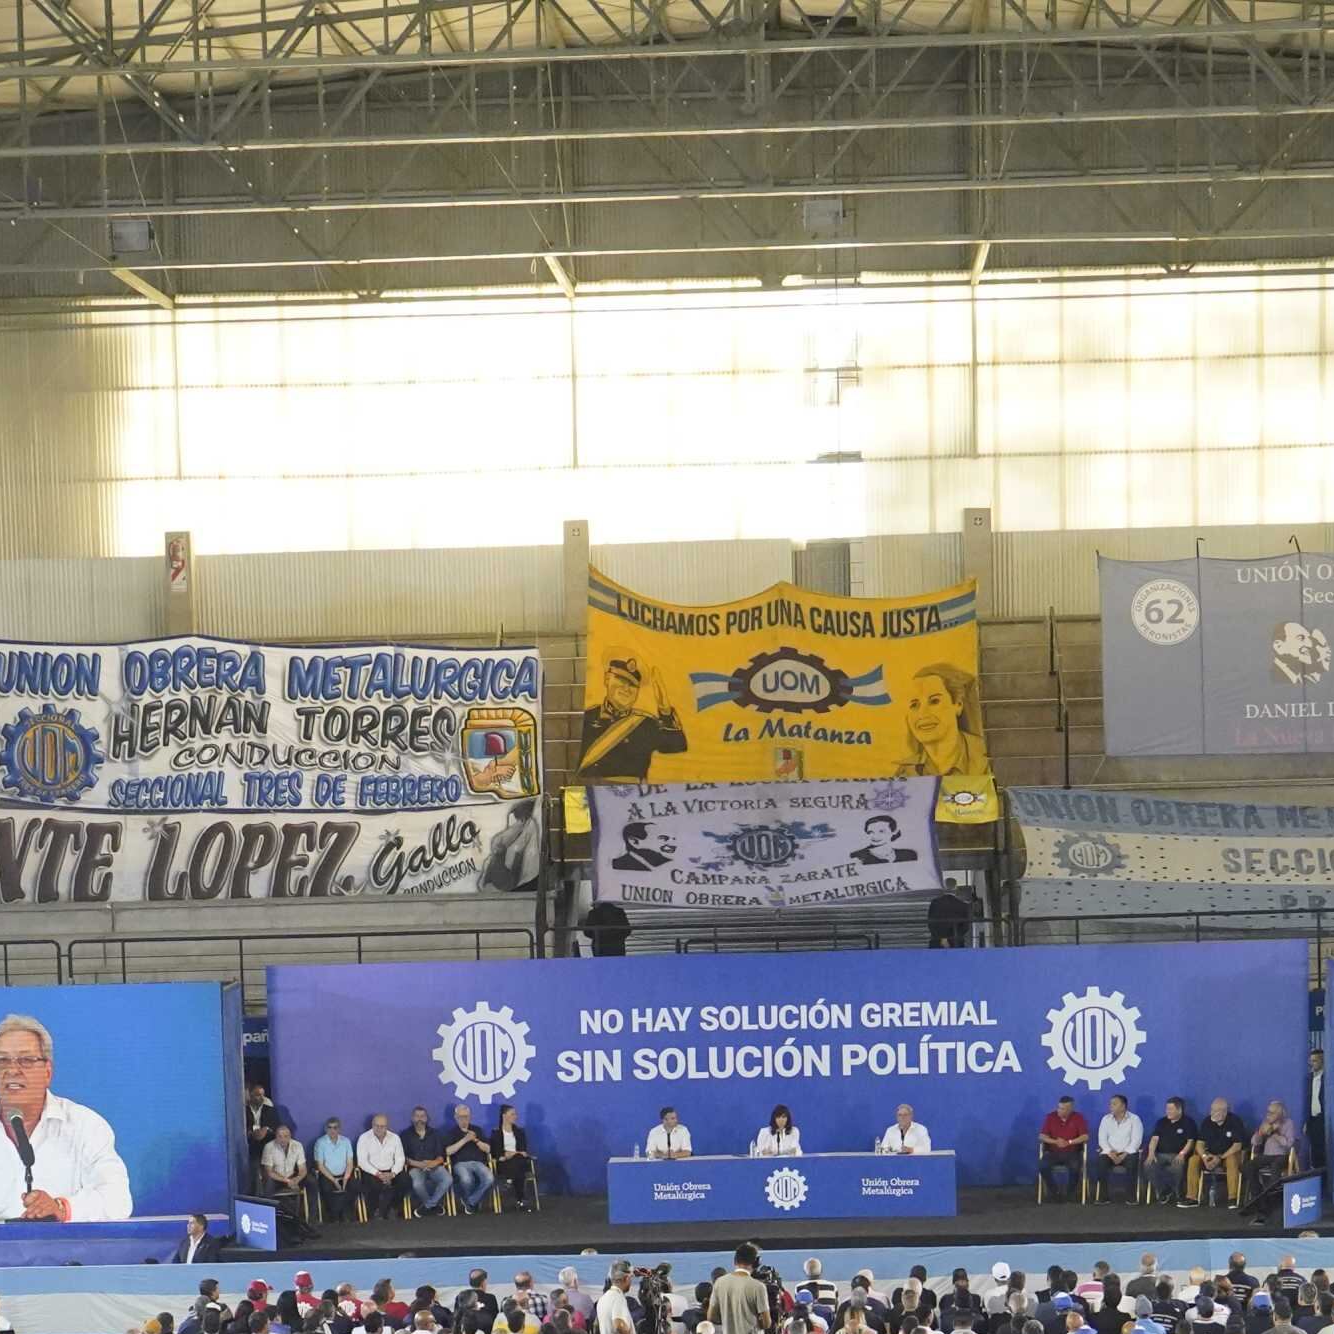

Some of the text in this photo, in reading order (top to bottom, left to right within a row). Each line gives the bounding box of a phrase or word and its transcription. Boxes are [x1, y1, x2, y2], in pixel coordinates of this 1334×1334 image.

[1236, 561, 1309, 584] UNIÓN
[615, 596, 720, 637] LUCHAMOS
[725, 605, 763, 635] POR
[767, 598, 806, 630] UNA
[809, 607, 875, 639] CAUSA
[1144, 599, 1186, 625] 62
[124, 645, 266, 697] OBRERA
[287, 653, 538, 701] METALURGICA
[762, 669, 821, 696] UOM
[1244, 702, 1323, 719] DANIEL
[111, 696, 457, 760] HERNAN TORRES
[722, 717, 873, 745] La Matanza
[171, 741, 401, 770] CONDUCCION
[108, 771, 228, 809] SECCIONAL
[244, 771, 304, 807] TRES
[315, 773, 348, 808] DE
[358, 773, 462, 808] FEBRERO
[626, 794, 870, 822] A LA VICTORIA SEGURA
[1130, 799, 1266, 831] OBRERA
[147, 819, 363, 900] LOPEZ
[371, 814, 481, 894] Gallo
[779, 863, 860, 885] ZARATE
[620, 876, 911, 908] UNION OBRERA METALURGICA
[579, 999, 998, 1035] NO HAY SOLUCIÓN GREMIAL
[455, 1022, 515, 1082] UOM
[1065, 1007, 1122, 1068] UOM
[556, 1034, 1022, 1084] SIN SOLUCIÓN POLÍTICA
[653, 1182, 680, 1192] Unión
[653, 1190, 706, 1201] Metalúrgica
[860, 1177, 888, 1187] Unión
[861, 1186, 914, 1197] Metalúrgica
